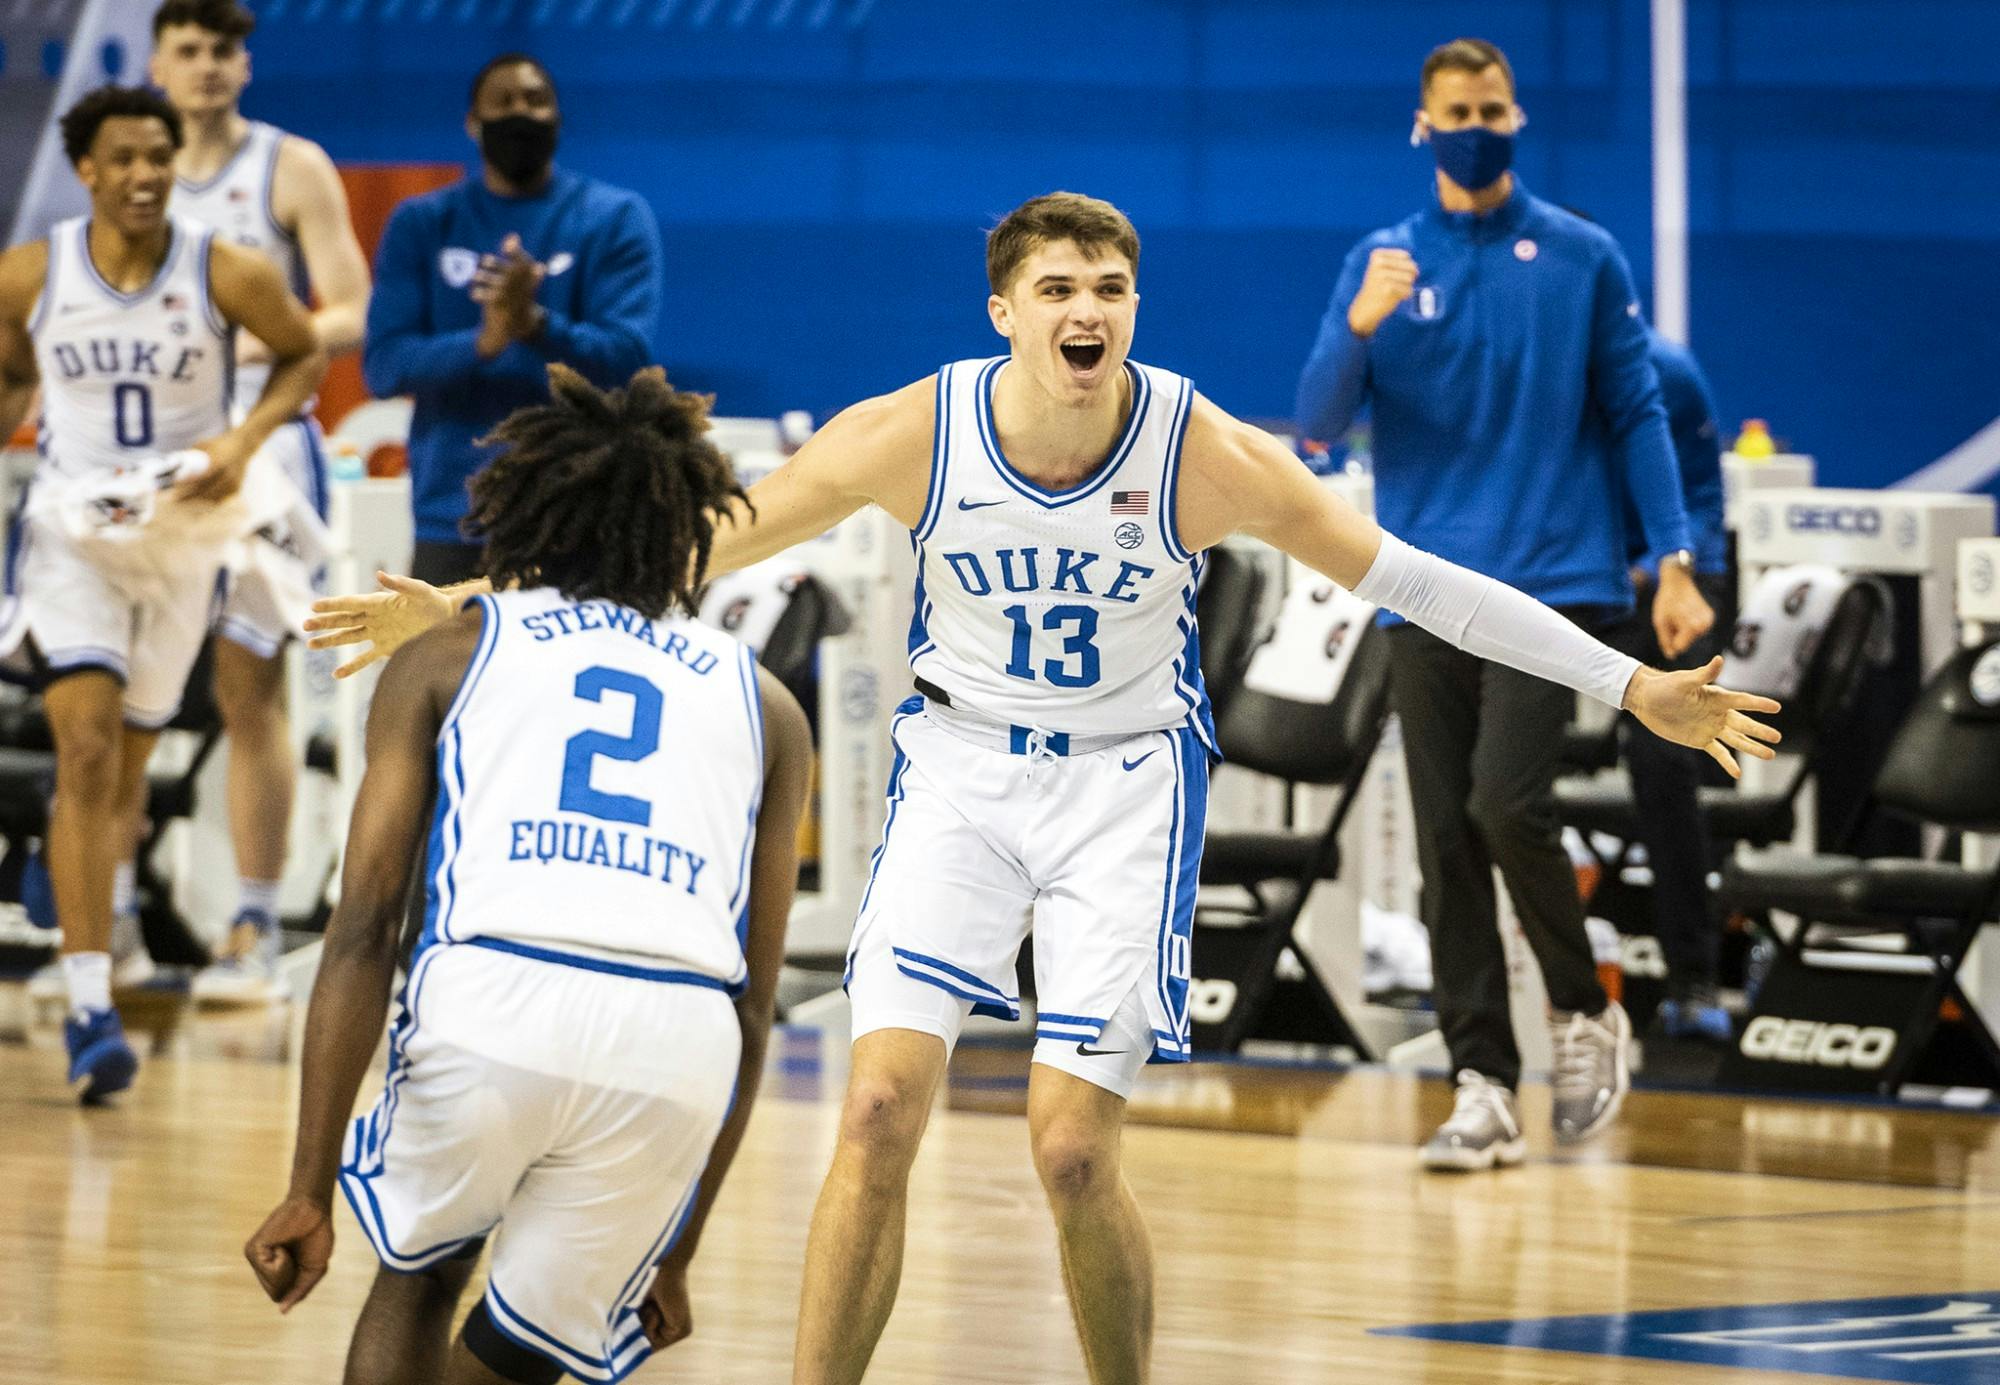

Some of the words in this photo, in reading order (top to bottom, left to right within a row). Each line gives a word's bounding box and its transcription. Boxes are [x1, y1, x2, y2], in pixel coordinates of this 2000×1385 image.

[54, 338, 205, 380] DUKE
[114, 382, 154, 447] 0
[943, 547, 1154, 603] DUKE
[521, 603, 719, 676] STEWARD
[1003, 605, 1101, 688] 13
[558, 665, 664, 826] 2
[509, 820, 706, 895] EQUALITY
[1740, 1016, 1896, 1069] GEICO
